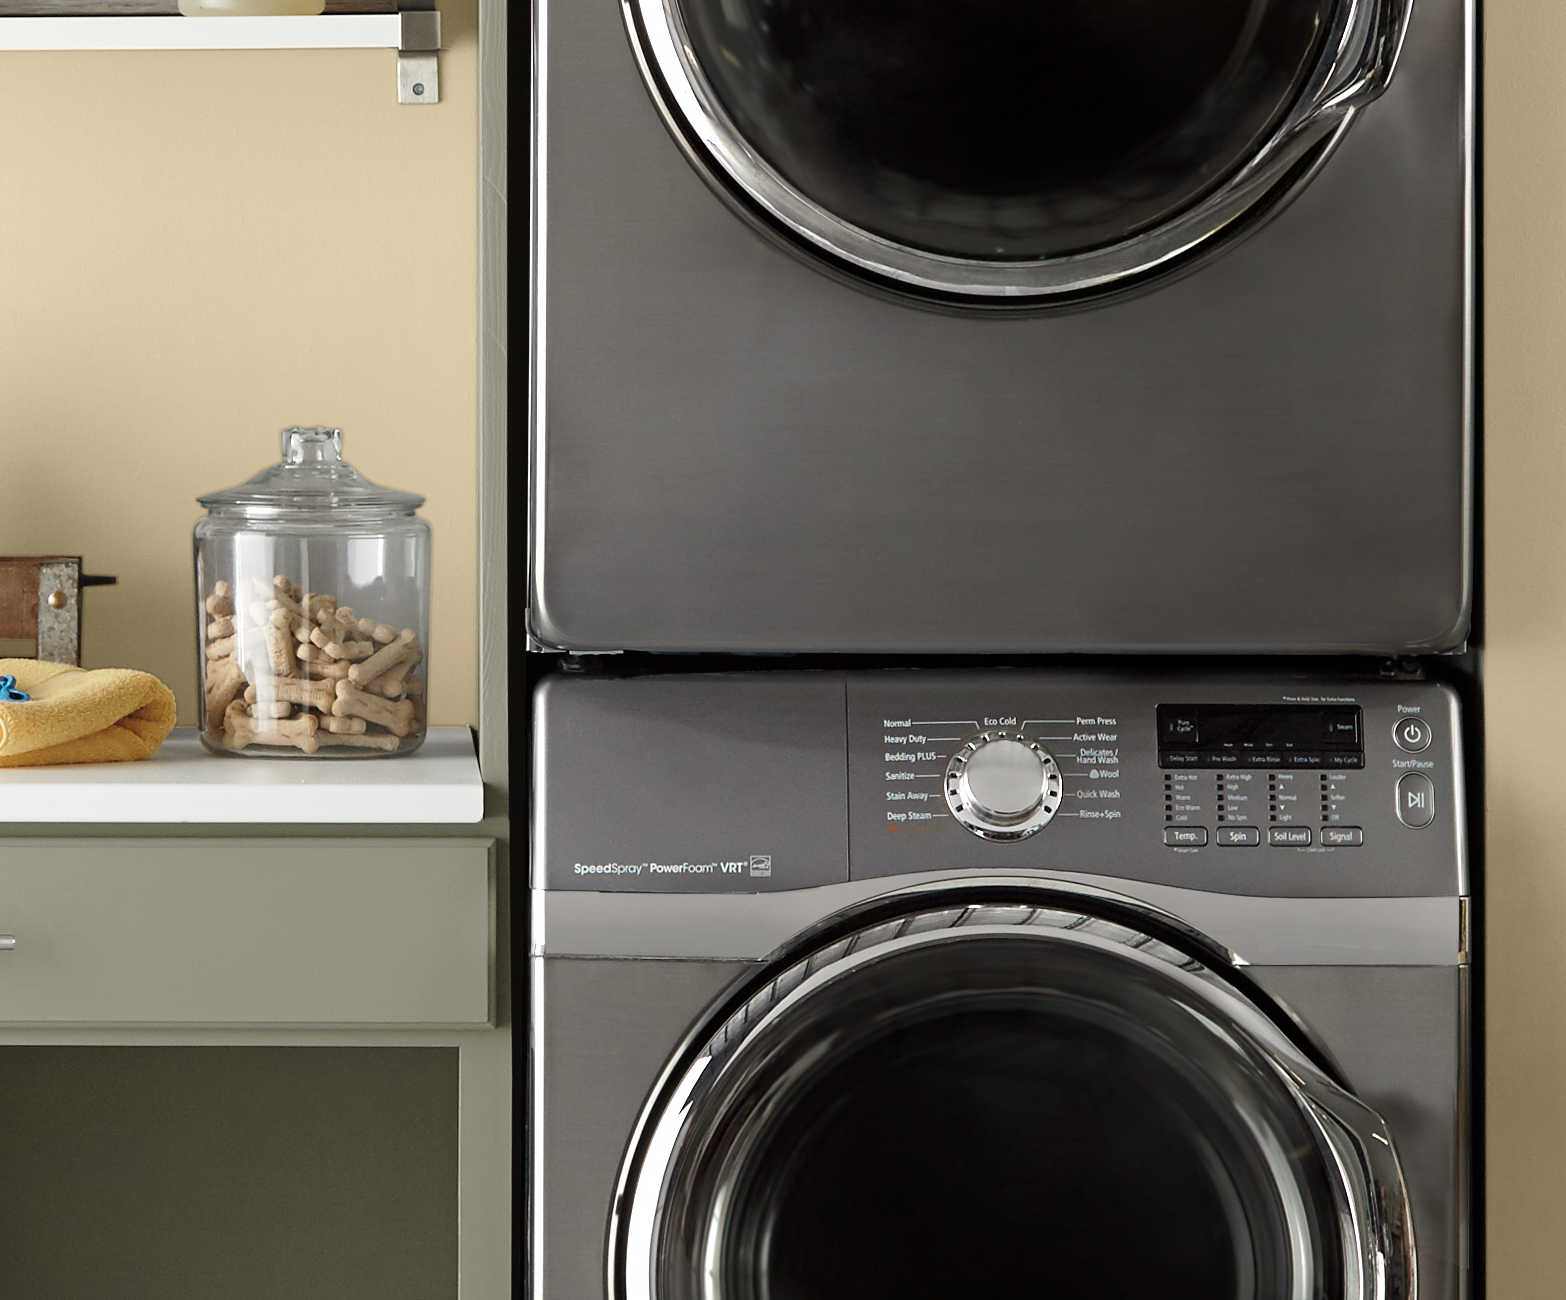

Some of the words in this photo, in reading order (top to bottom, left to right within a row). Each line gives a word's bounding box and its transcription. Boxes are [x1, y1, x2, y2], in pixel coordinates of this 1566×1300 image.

[1397, 705, 1421, 713] Power
[883, 719, 911, 728] Normal
[984, 717, 998, 726] Eco
[999, 717, 1016, 725] Cold
[1076, 717, 1096, 725] Perm
[1097, 717, 1117, 725] Press
[884, 735, 907, 745] Heavy
[908, 734, 927, 745] Duty
[1073, 733, 1097, 741] Active
[1097, 733, 1117, 741] Wear
[1080, 748, 1114, 756] Delicates
[885, 752, 916, 762] Bedding
[917, 752, 936, 760] PLUS
[1076, 756, 1096, 764] Hand
[1098, 756, 1119, 764] Wash
[1392, 759, 1434, 768] Start/Pause
[885, 771, 915, 781] Sanitize
[1099, 769, 1119, 778] Wool
[886, 791, 906, 801] Stain
[907, 792, 929, 801] Away
[1076, 790, 1098, 799] Quick
[1099, 790, 1120, 798] Wash
[887, 812, 907, 822] Deep
[908, 811, 932, 820] Steam
[1079, 810, 1121, 820] Rinse+Spin
[1174, 832, 1198, 842] Temp.
[1230, 832, 1247, 842] Spin
[1274, 832, 1288, 841] Soil
[1288, 832, 1306, 841] Level
[1329, 831, 1353, 842] Signal
